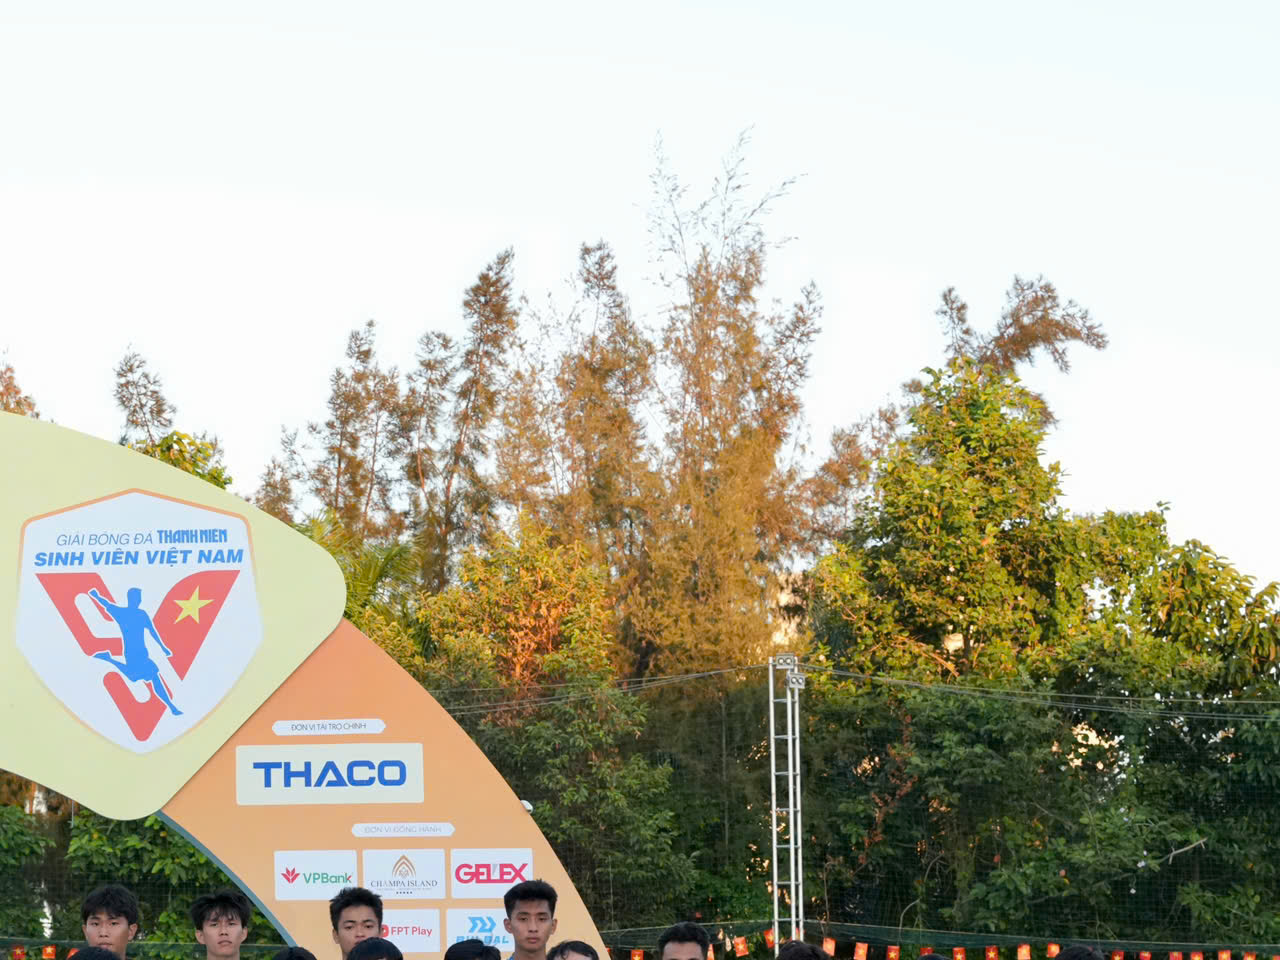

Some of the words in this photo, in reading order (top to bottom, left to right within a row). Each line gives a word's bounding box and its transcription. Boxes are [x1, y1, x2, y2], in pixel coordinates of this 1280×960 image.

[34, 552, 84, 567] SINH
[91, 548, 139, 566] VIÊN
[146, 547, 193, 567] VIỆT
[197, 549, 244, 564] NAM
[253, 759, 407, 788] THACO
[303, 872, 352, 884] VPBank
[455, 863, 529, 884] GELEX
[371, 879, 405, 887] CHAMPA
[408, 879, 438, 887] ISLAND
[391, 926, 410, 936] FPT
[412, 926, 433, 937] Play
